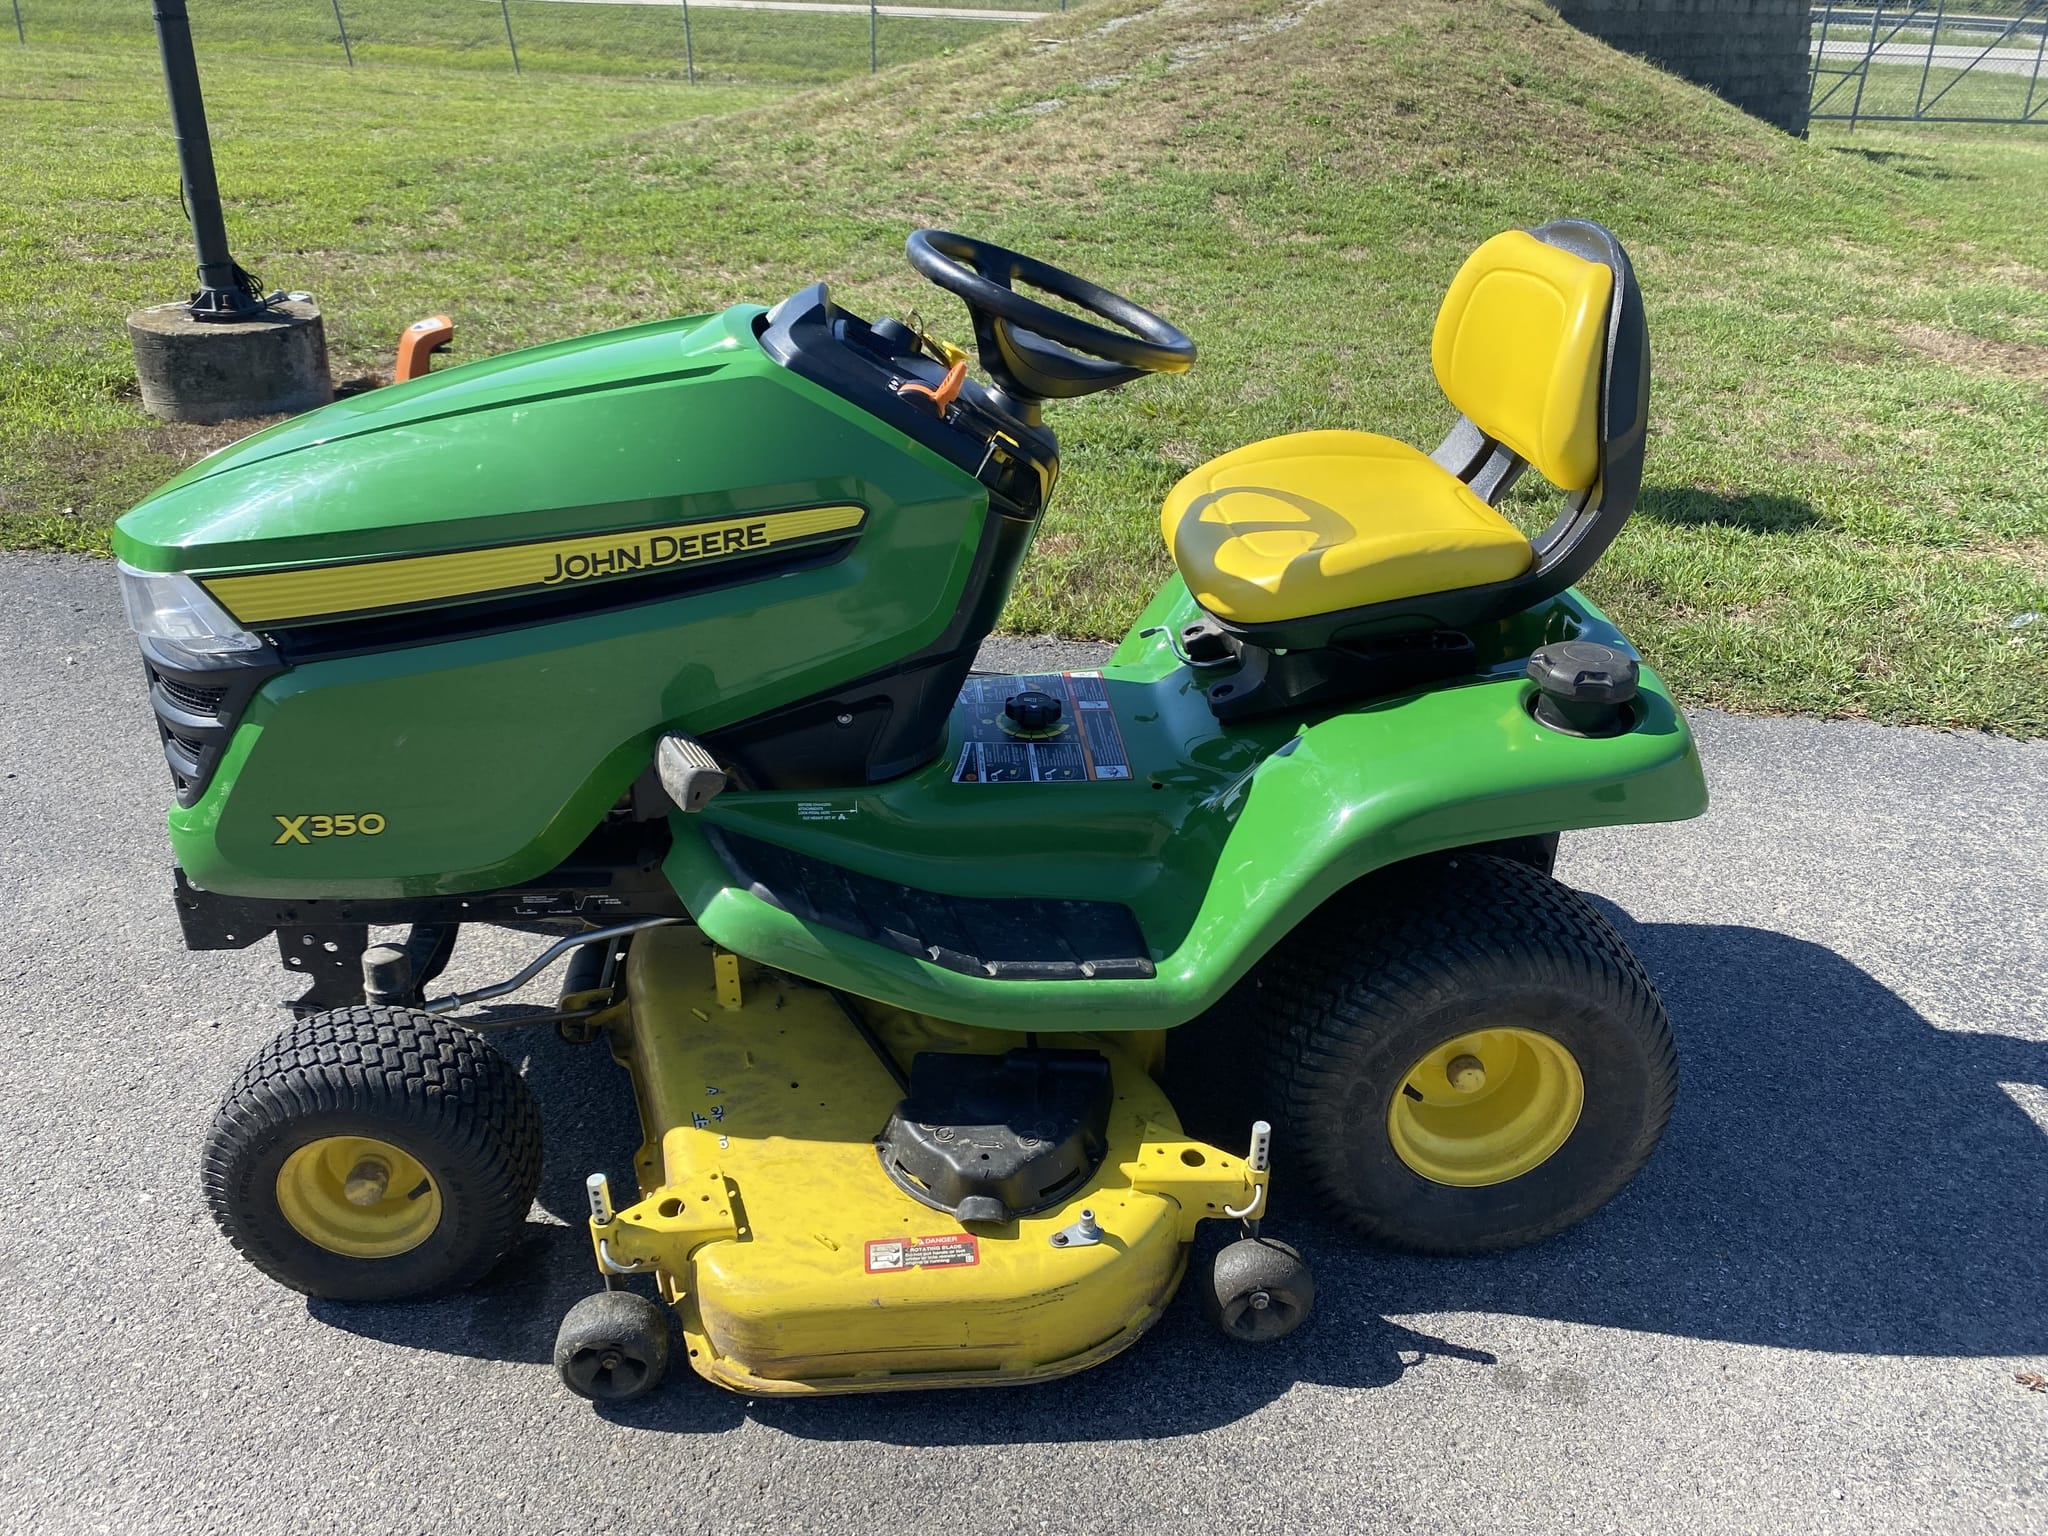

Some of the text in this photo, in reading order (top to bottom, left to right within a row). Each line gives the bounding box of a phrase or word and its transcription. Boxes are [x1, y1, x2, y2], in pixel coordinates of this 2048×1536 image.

[544, 523, 768, 583] JOHN DEERE
[272, 813, 387, 845] X350
[925, 1236, 958, 1244] DANGER
